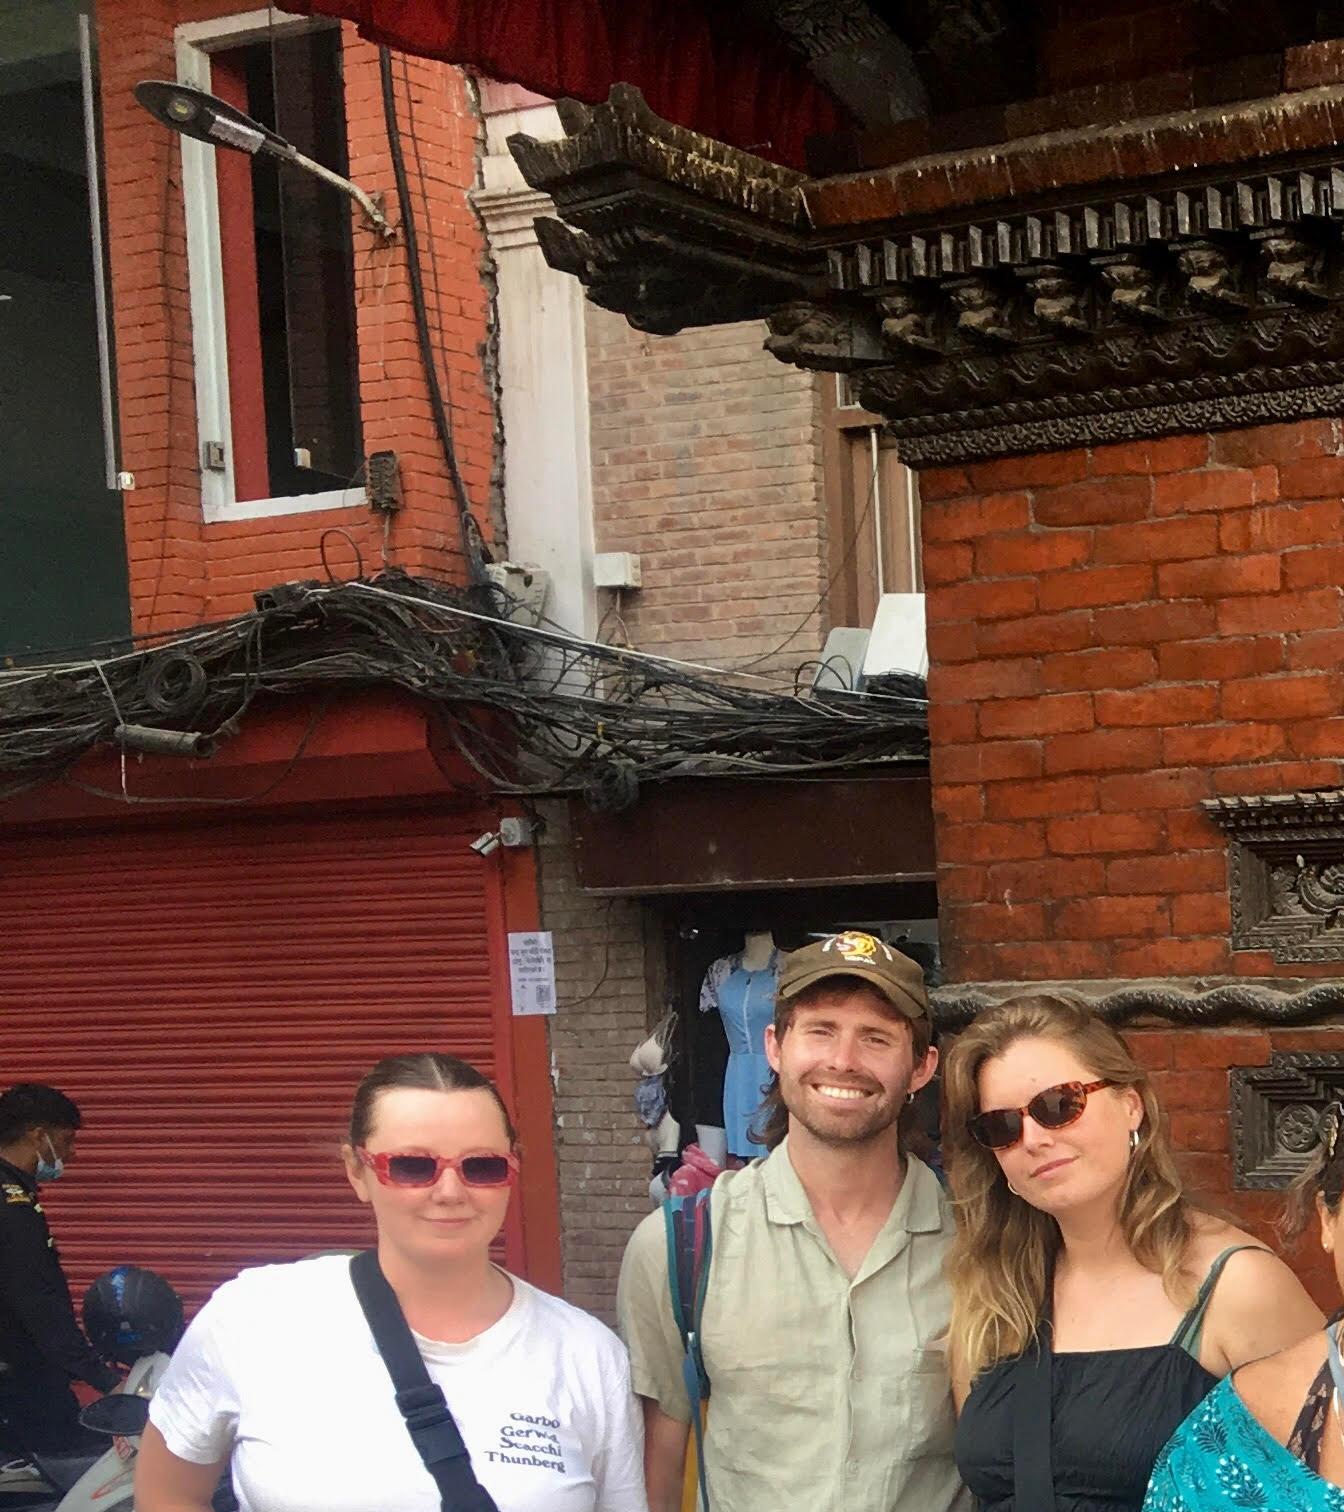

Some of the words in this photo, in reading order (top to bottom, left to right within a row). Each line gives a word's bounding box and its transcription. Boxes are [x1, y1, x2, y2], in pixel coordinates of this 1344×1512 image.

[510, 1412, 561, 1429] Garbo
[499, 1436, 562, 1457] Scacchi
[483, 1450, 566, 1473] Thunberg
